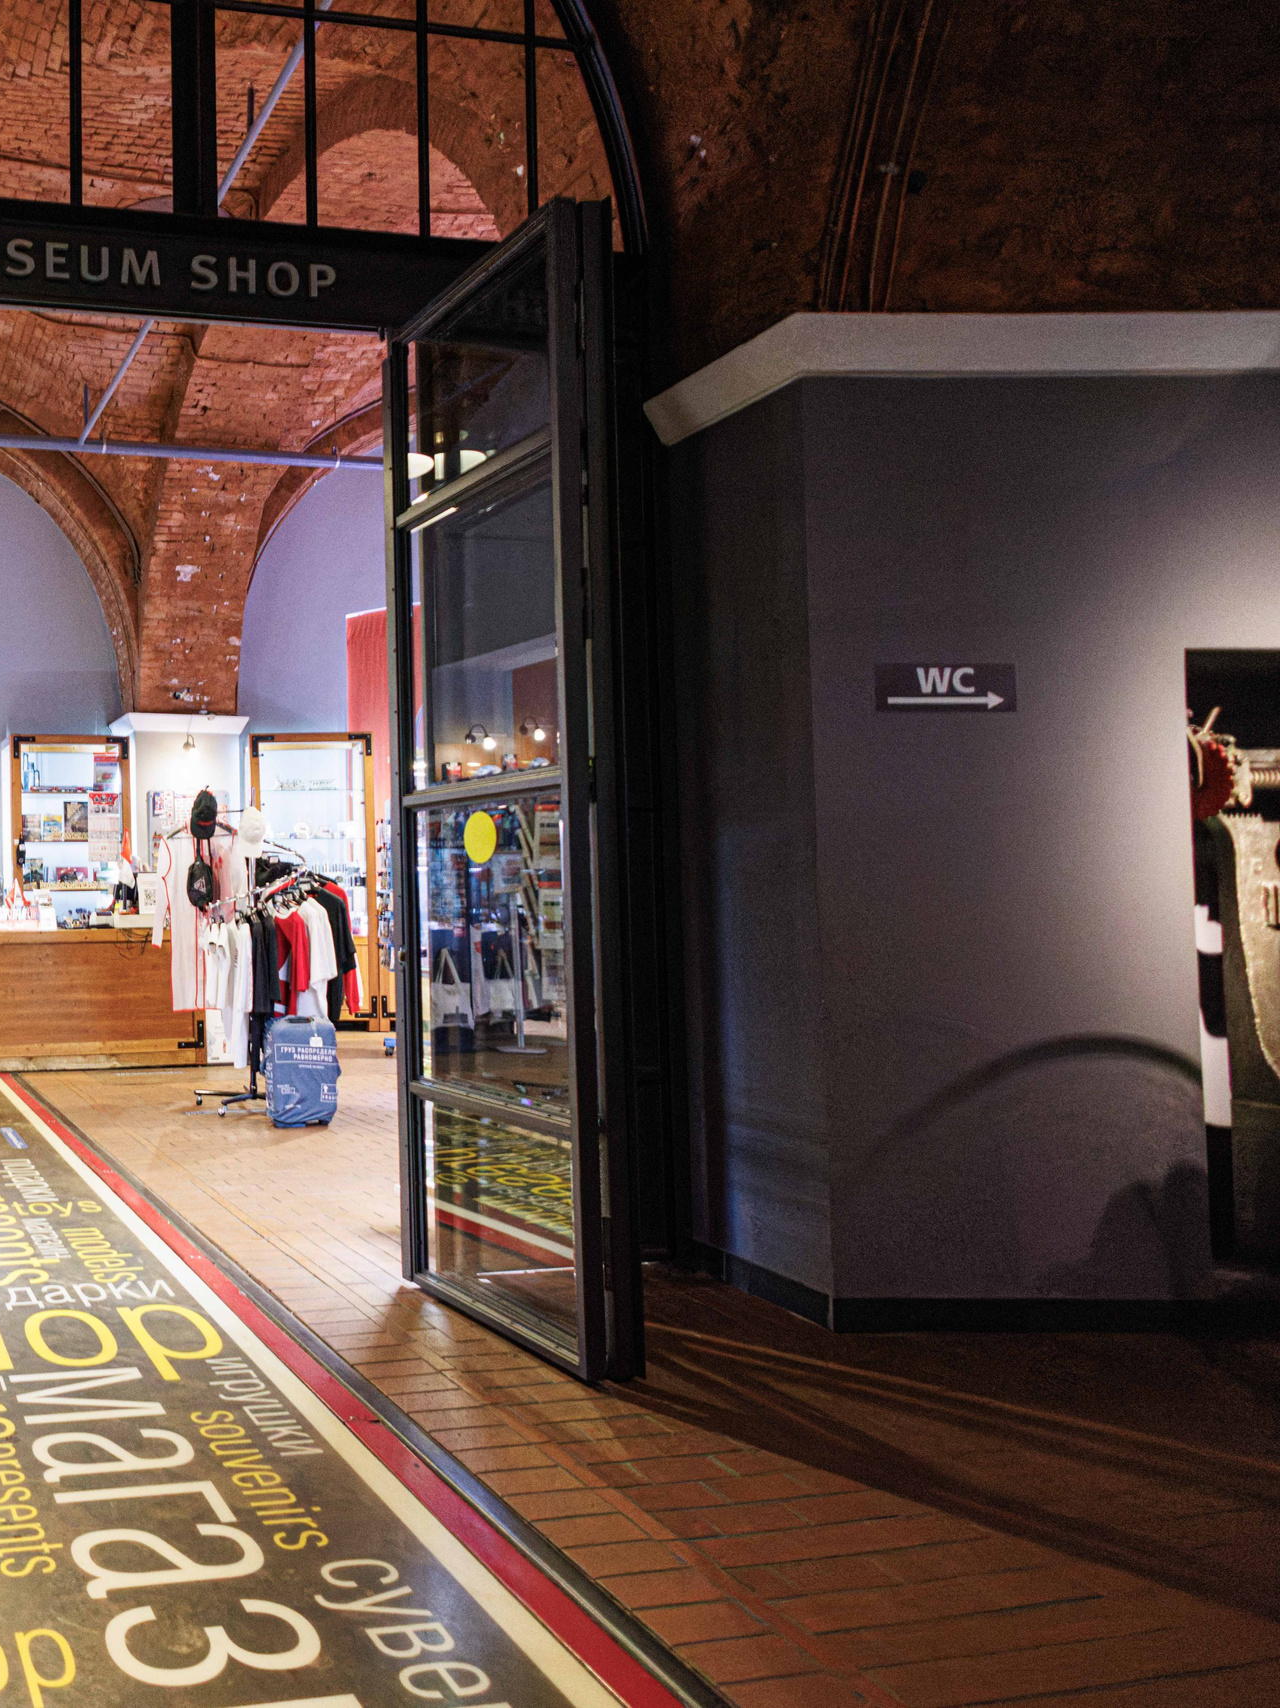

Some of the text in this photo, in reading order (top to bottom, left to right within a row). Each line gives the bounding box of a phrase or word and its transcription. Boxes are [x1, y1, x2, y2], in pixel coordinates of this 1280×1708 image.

[189, 254, 338, 298] SHOP
[915, 666, 976, 695] WC
[280, 1045, 296, 1054] ГРУЗ
[293, 1053, 333, 1062] РАВНОМЕРНО
[0, 1158, 60, 1203] подарки
[12, 1200, 102, 1218] toys
[61, 1227, 144, 1284] models
[205, 1357, 324, 1458] игрушки
[190, 1410, 329, 1552] souvenirs
[9, 1366, 366, 1708] магаз
[314, 1558, 514, 1708] суве
